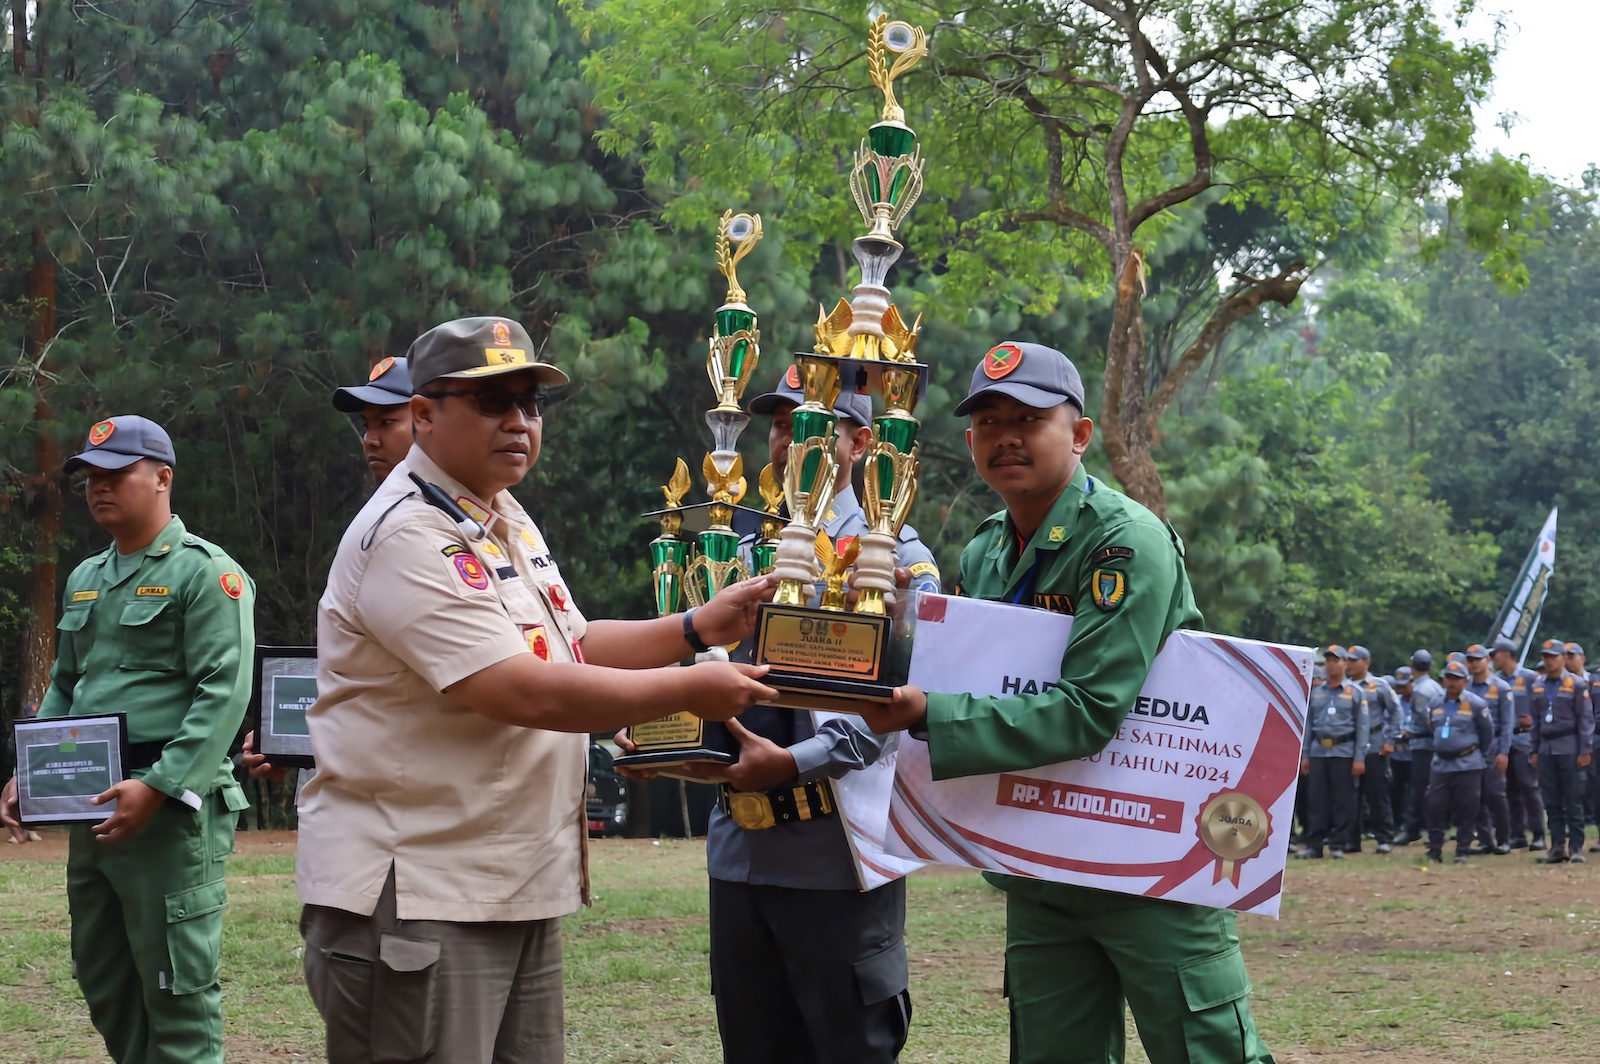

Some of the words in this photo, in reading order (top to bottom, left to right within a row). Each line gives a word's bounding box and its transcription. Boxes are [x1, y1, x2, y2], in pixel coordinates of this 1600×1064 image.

[800, 634, 832, 645] JUARA
[1129, 696, 1209, 725] EDUA
[1130, 728, 1242, 759] SATLINMAS
[1107, 751, 1179, 775] TAHUN
[1184, 763, 1230, 784] 2024
[1012, 782, 1045, 806] RP.
[1219, 815, 1252, 827] JUARA
[1232, 828, 1239, 837] 2
